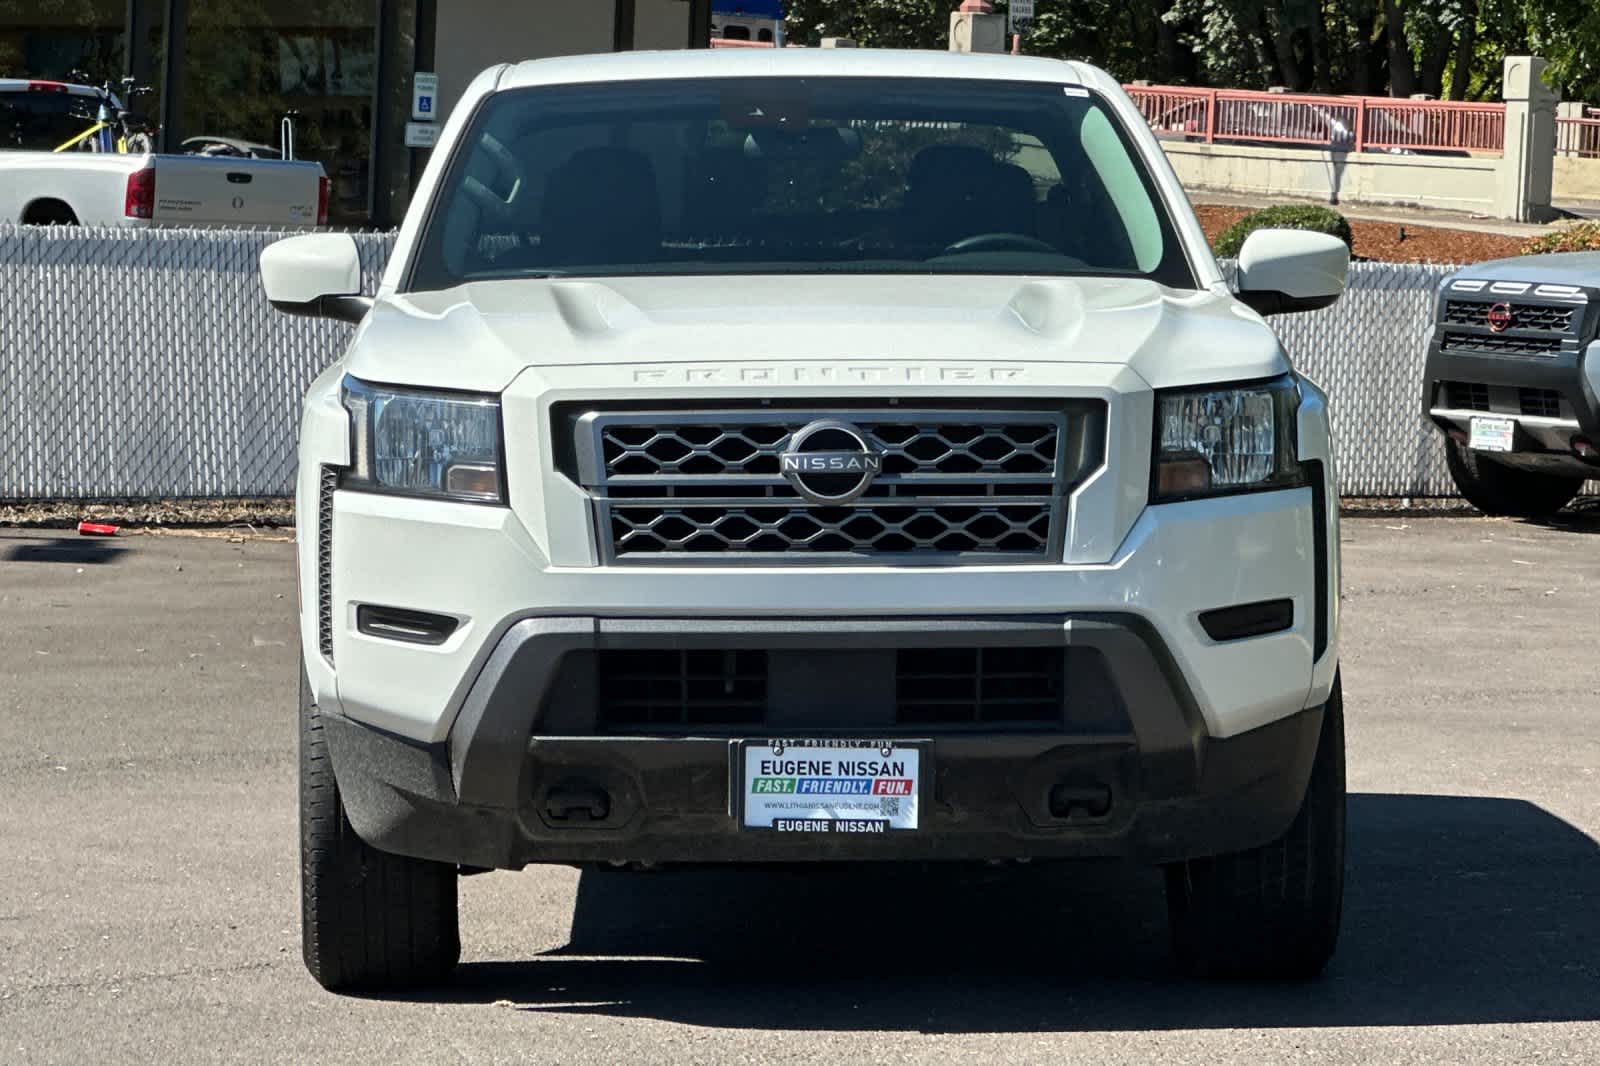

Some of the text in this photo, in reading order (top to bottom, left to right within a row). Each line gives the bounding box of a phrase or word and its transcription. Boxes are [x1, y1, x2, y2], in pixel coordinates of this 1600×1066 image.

[634, 368, 1025, 382] FRONTIER
[784, 457, 879, 470] NISSAN
[761, 760, 905, 777] EUGENE NISSAN
[756, 780, 909, 794] FAST. FRIENDLY. FUN.
[777, 820, 885, 833] EUGENE NISSAN
